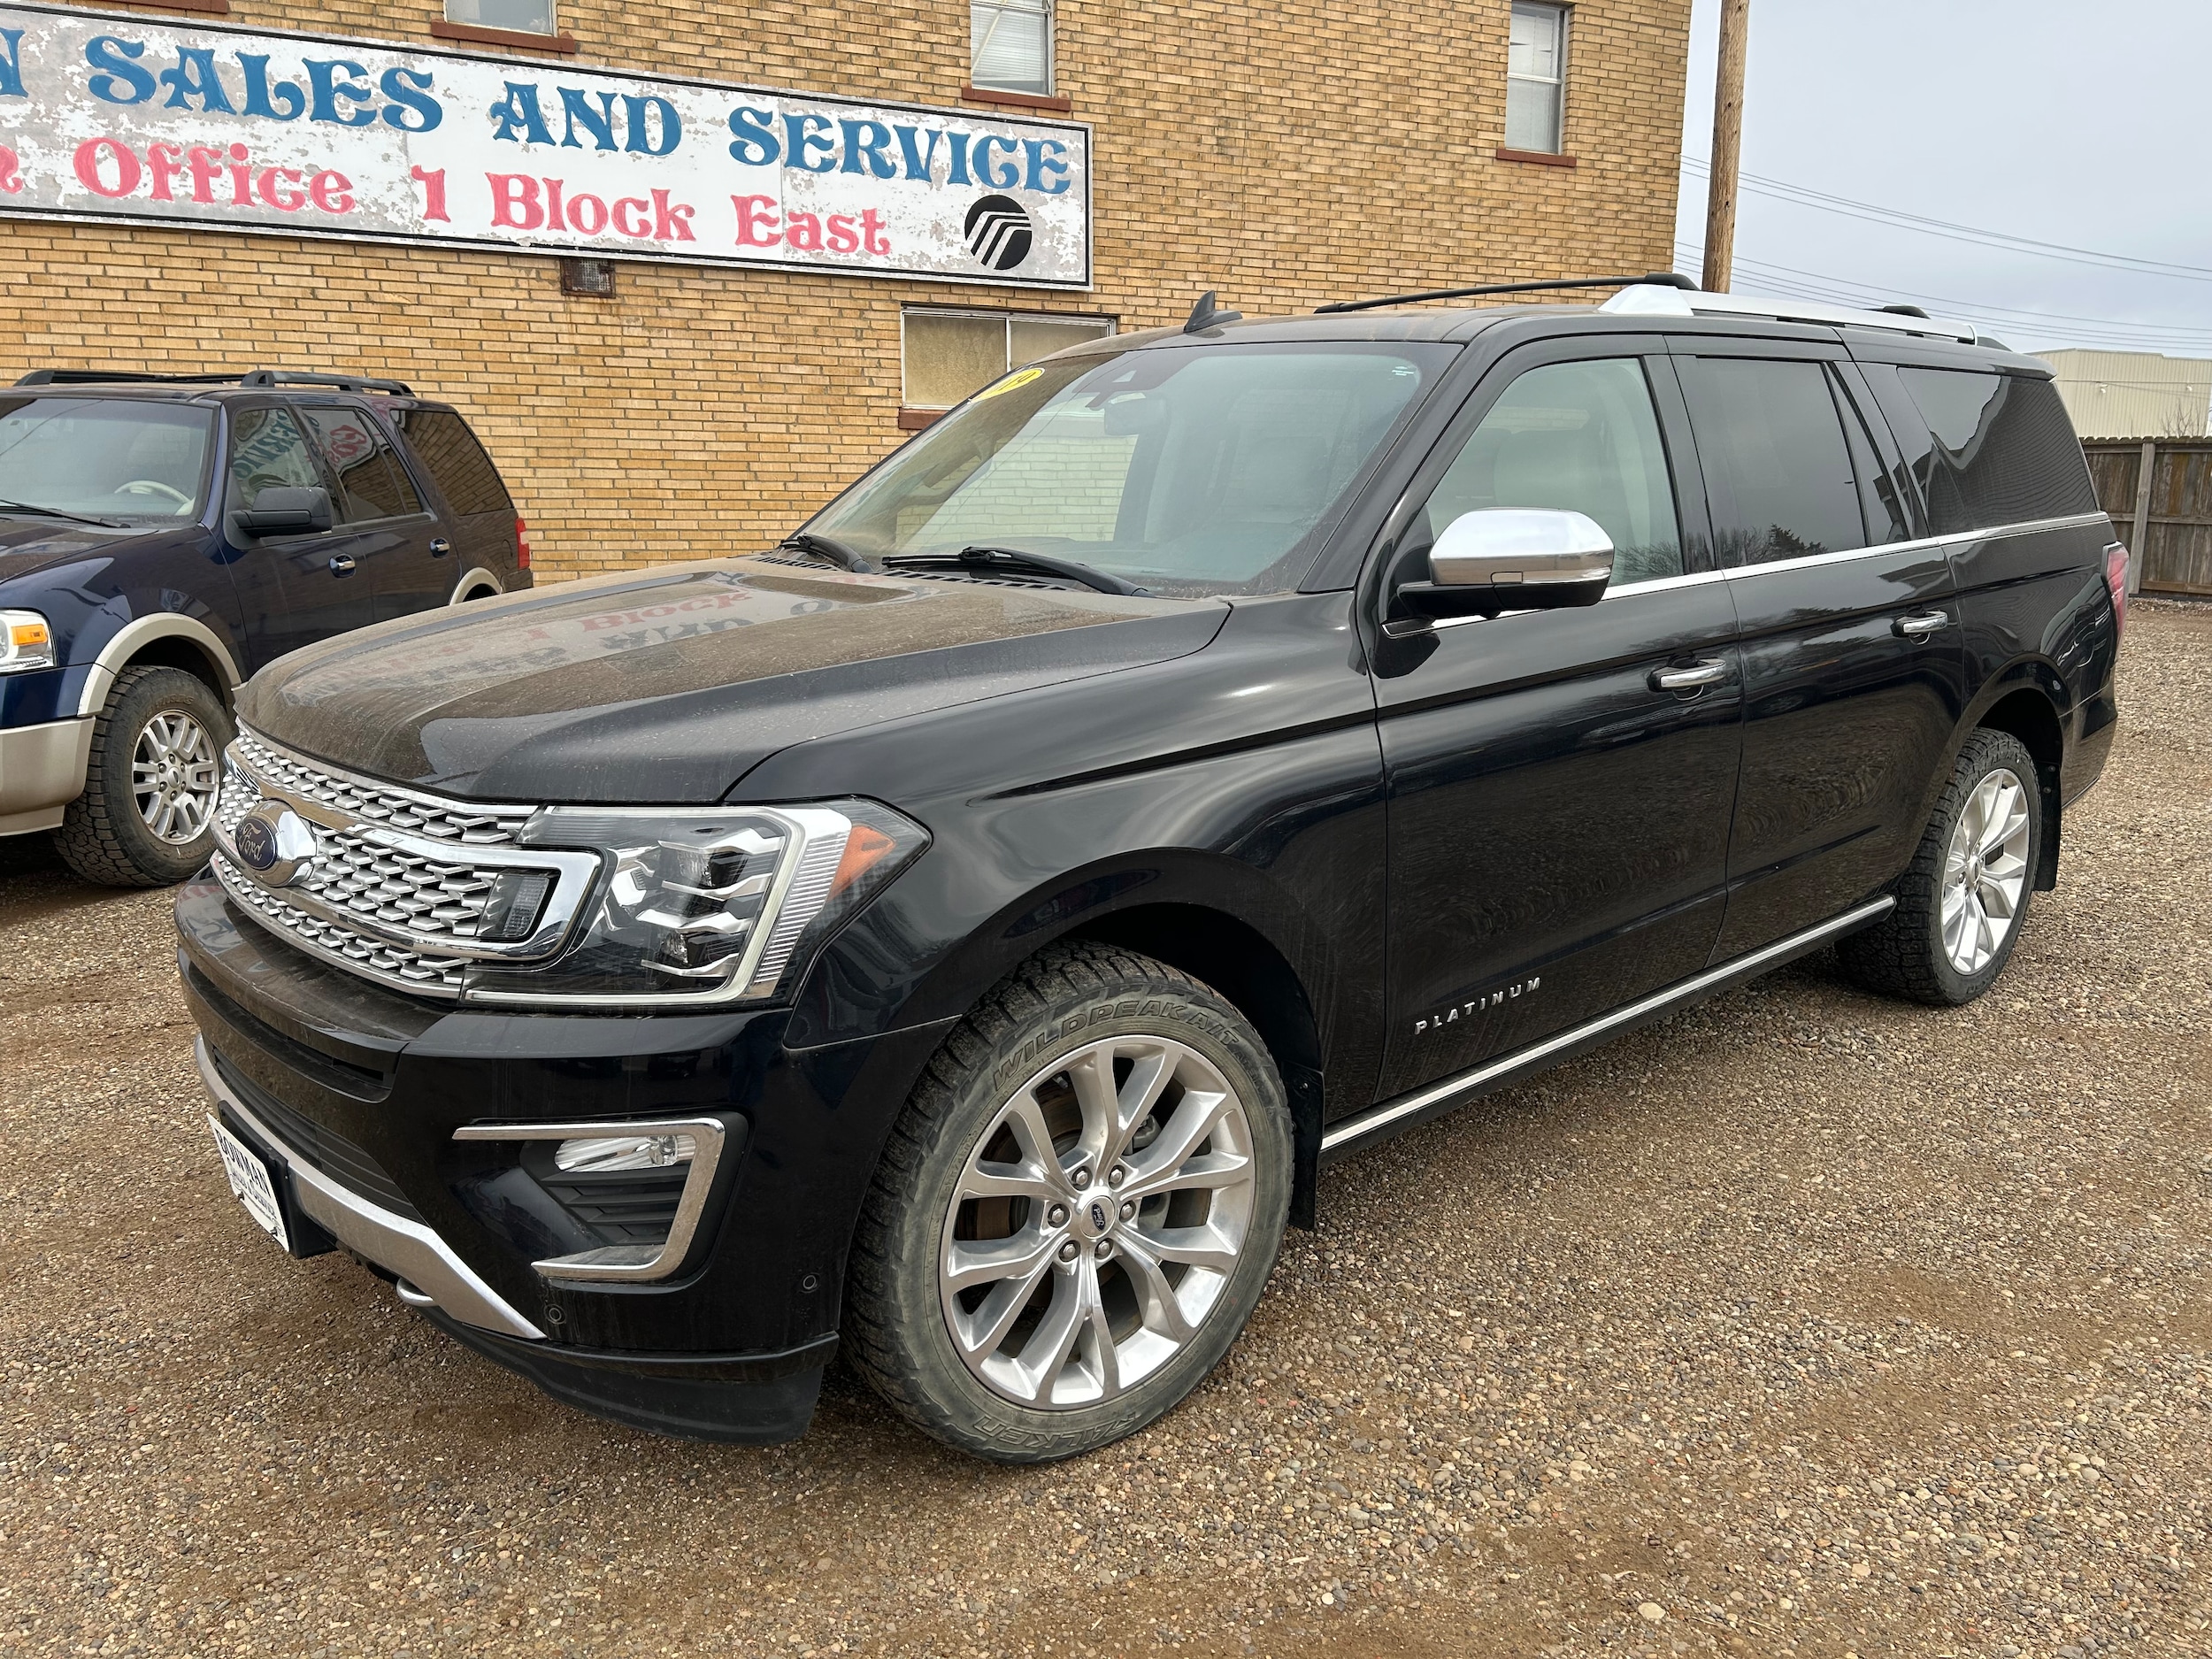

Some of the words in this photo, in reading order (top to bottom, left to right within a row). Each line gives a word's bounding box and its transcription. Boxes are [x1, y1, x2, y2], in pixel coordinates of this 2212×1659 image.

[85, 35, 442, 132] SALES
[491, 81, 682, 156] AND
[728, 106, 1071, 194] SERVICE
[73, 137, 356, 213] Office
[411, 165, 450, 223] 1
[485, 172, 695, 242] Block
[731, 194, 891, 256] East
[238, 822, 265, 862] Ford
[1414, 977, 1540, 1034] PLATINUM
[993, 1000, 1187, 1091] WILDPEAK
[215, 1127, 272, 1199] BOWMAN
[1093, 1206, 1106, 1227] Ford
